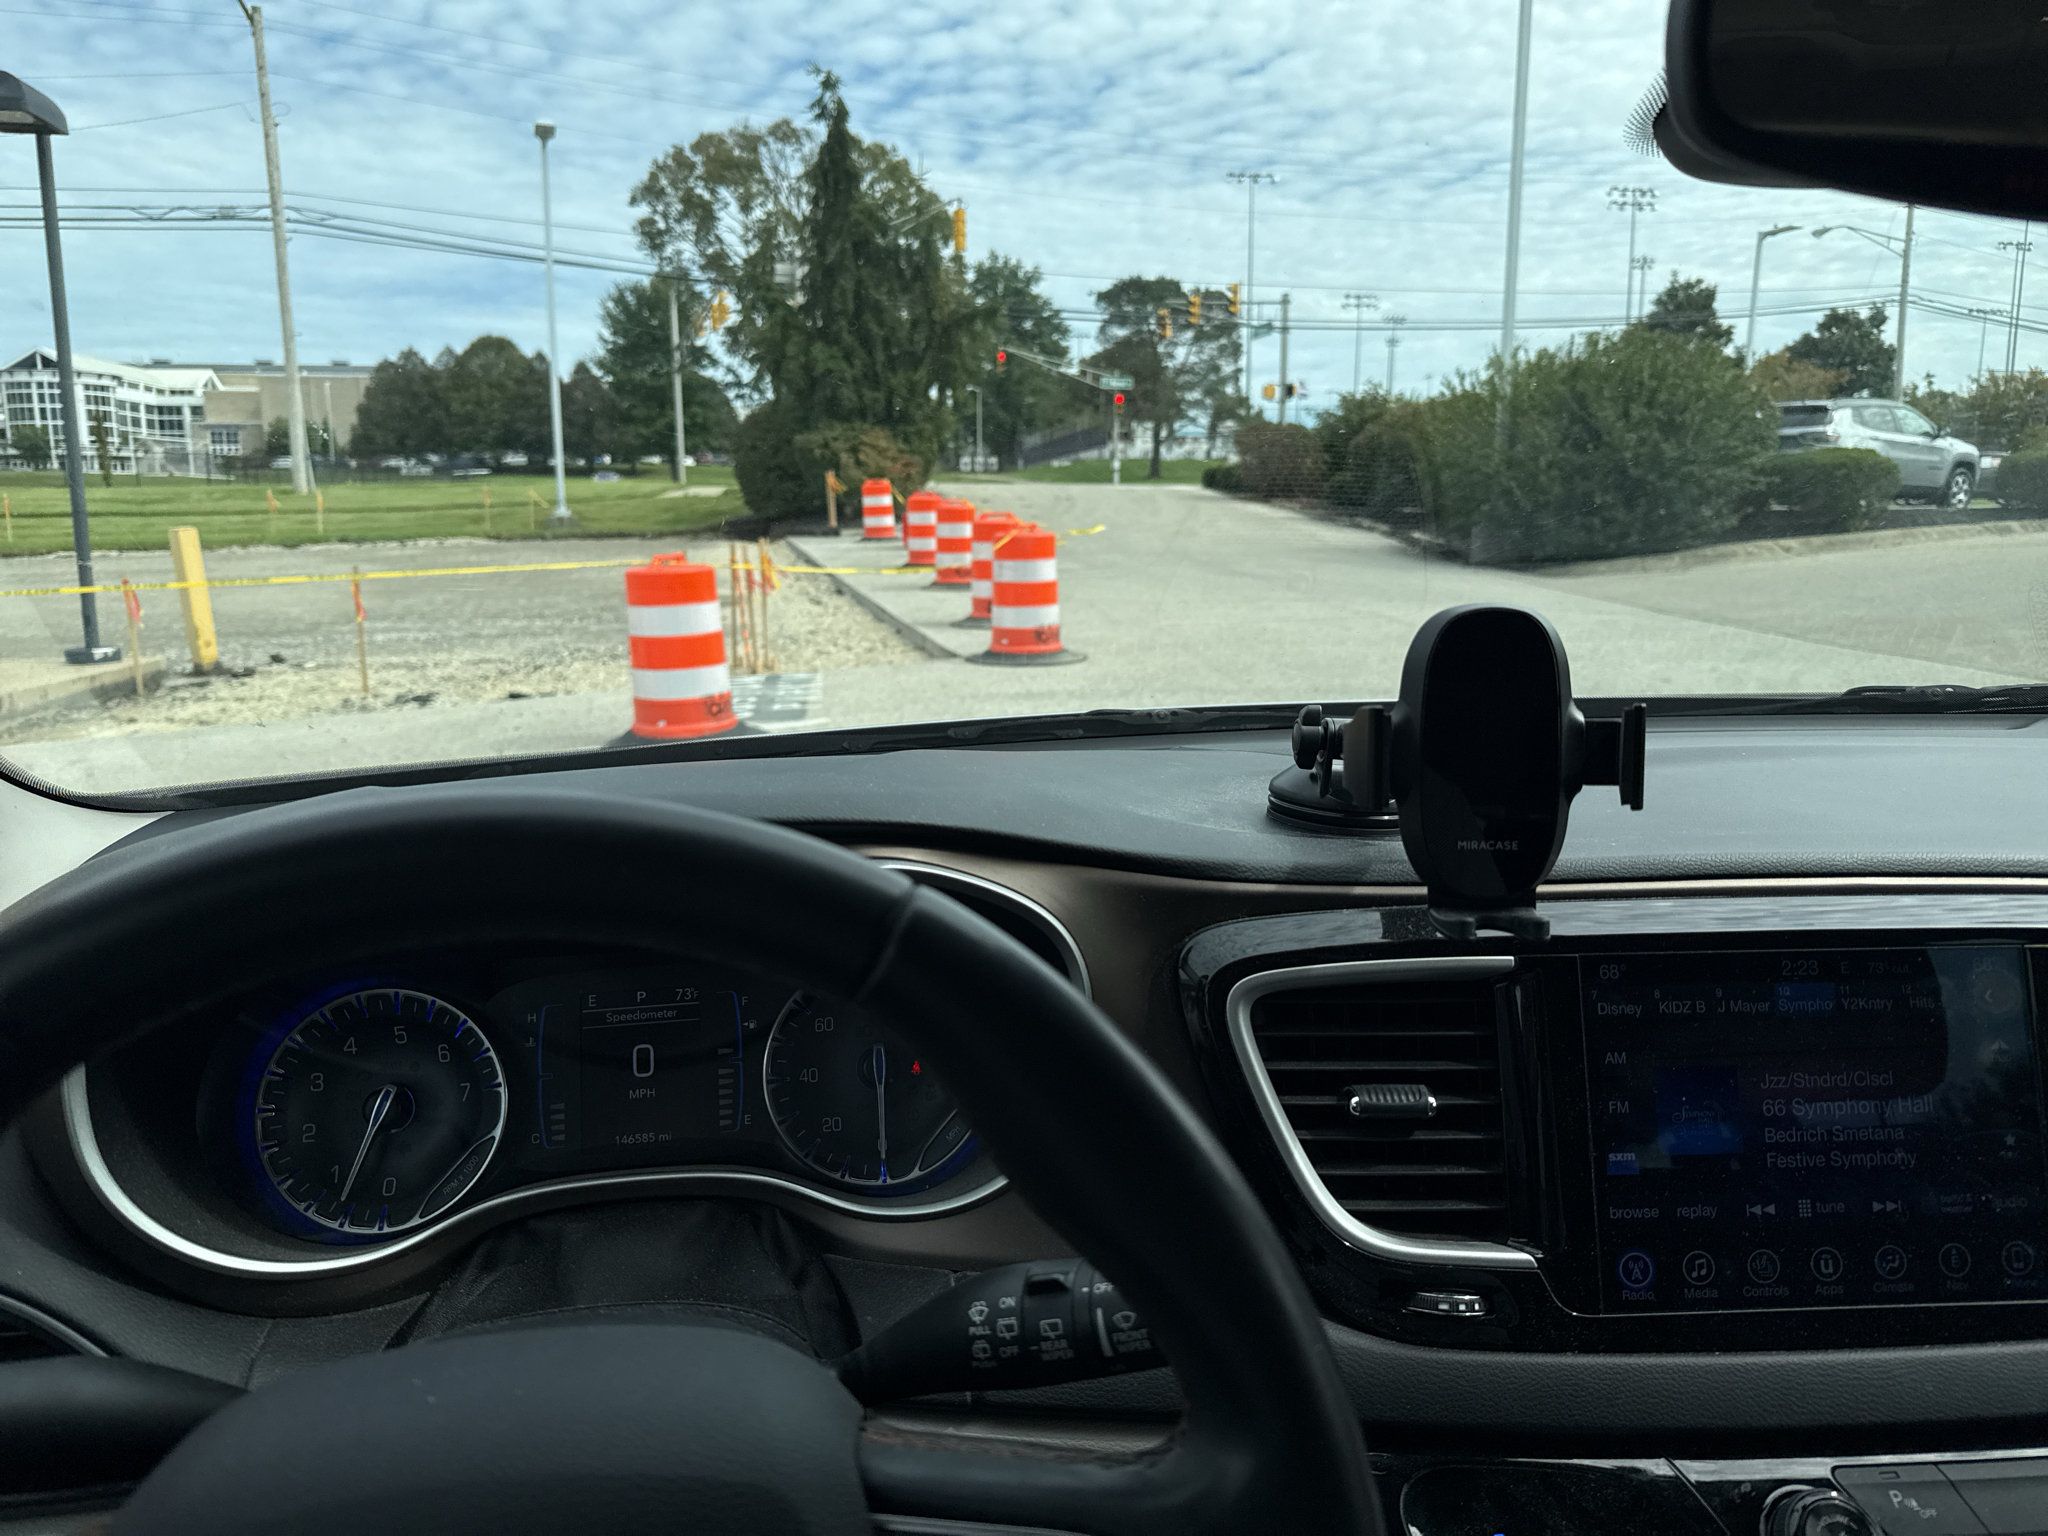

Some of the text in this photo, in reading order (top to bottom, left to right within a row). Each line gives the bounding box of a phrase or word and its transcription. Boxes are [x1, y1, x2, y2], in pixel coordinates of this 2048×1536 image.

[1457, 839, 1520, 851] MIRACASE
[1599, 963, 1627, 980] 68°
[1781, 959, 1820, 976] 2:23
[588, 994, 598, 1007] E
[637, 991, 647, 1003] P
[1653, 988, 1662, 1000] 8
[1713, 987, 1723, 998] 9
[1598, 1001, 1643, 1018] Disney
[1658, 1000, 1707, 1014] KIDZ B
[1716, 999, 1770, 1016] J Mayer
[1778, 997, 1833, 1014] Sympho
[1841, 997, 1893, 1013] Y2Kntry
[606, 1008, 678, 1022] Speedometer
[814, 1017, 834, 1032] 60
[394, 1026, 408, 1044] 5
[344, 1037, 358, 1055] 4
[437, 1044, 451, 1062] 6
[632, 1044, 655, 1078] 0
[1605, 1051, 1627, 1065] AM
[310, 1073, 325, 1092] 3
[800, 1067, 819, 1083] 40
[1760, 1070, 1894, 1090] Jzz/Stndrd/Clscl
[459, 1083, 471, 1103] 7
[628, 1088, 656, 1100] MPH
[1609, 1101, 1631, 1114] FM
[1762, 1094, 1934, 1119] 66 Symphony Hall
[822, 1116, 842, 1132] 20
[302, 1123, 316, 1143] 2
[615, 1132, 672, 1146] 146585 mi
[1764, 1126, 1905, 1143] Bedrich Smetana
[1608, 1152, 1636, 1162] sxm
[1766, 1150, 1917, 1169] Festive Symphony
[331, 1165, 340, 1184] 1
[382, 1177, 396, 1196] 0
[1609, 1205, 1660, 1219] browse
[1677, 1204, 1718, 1220] replay
[1815, 1200, 1846, 1214] tune
[1622, 1289, 1655, 1301] Radio
[1684, 1287, 1720, 1299] Media
[1743, 1285, 1791, 1298] Controls
[1815, 1284, 1845, 1298] Apps
[998, 1296, 1016, 1309] ON
